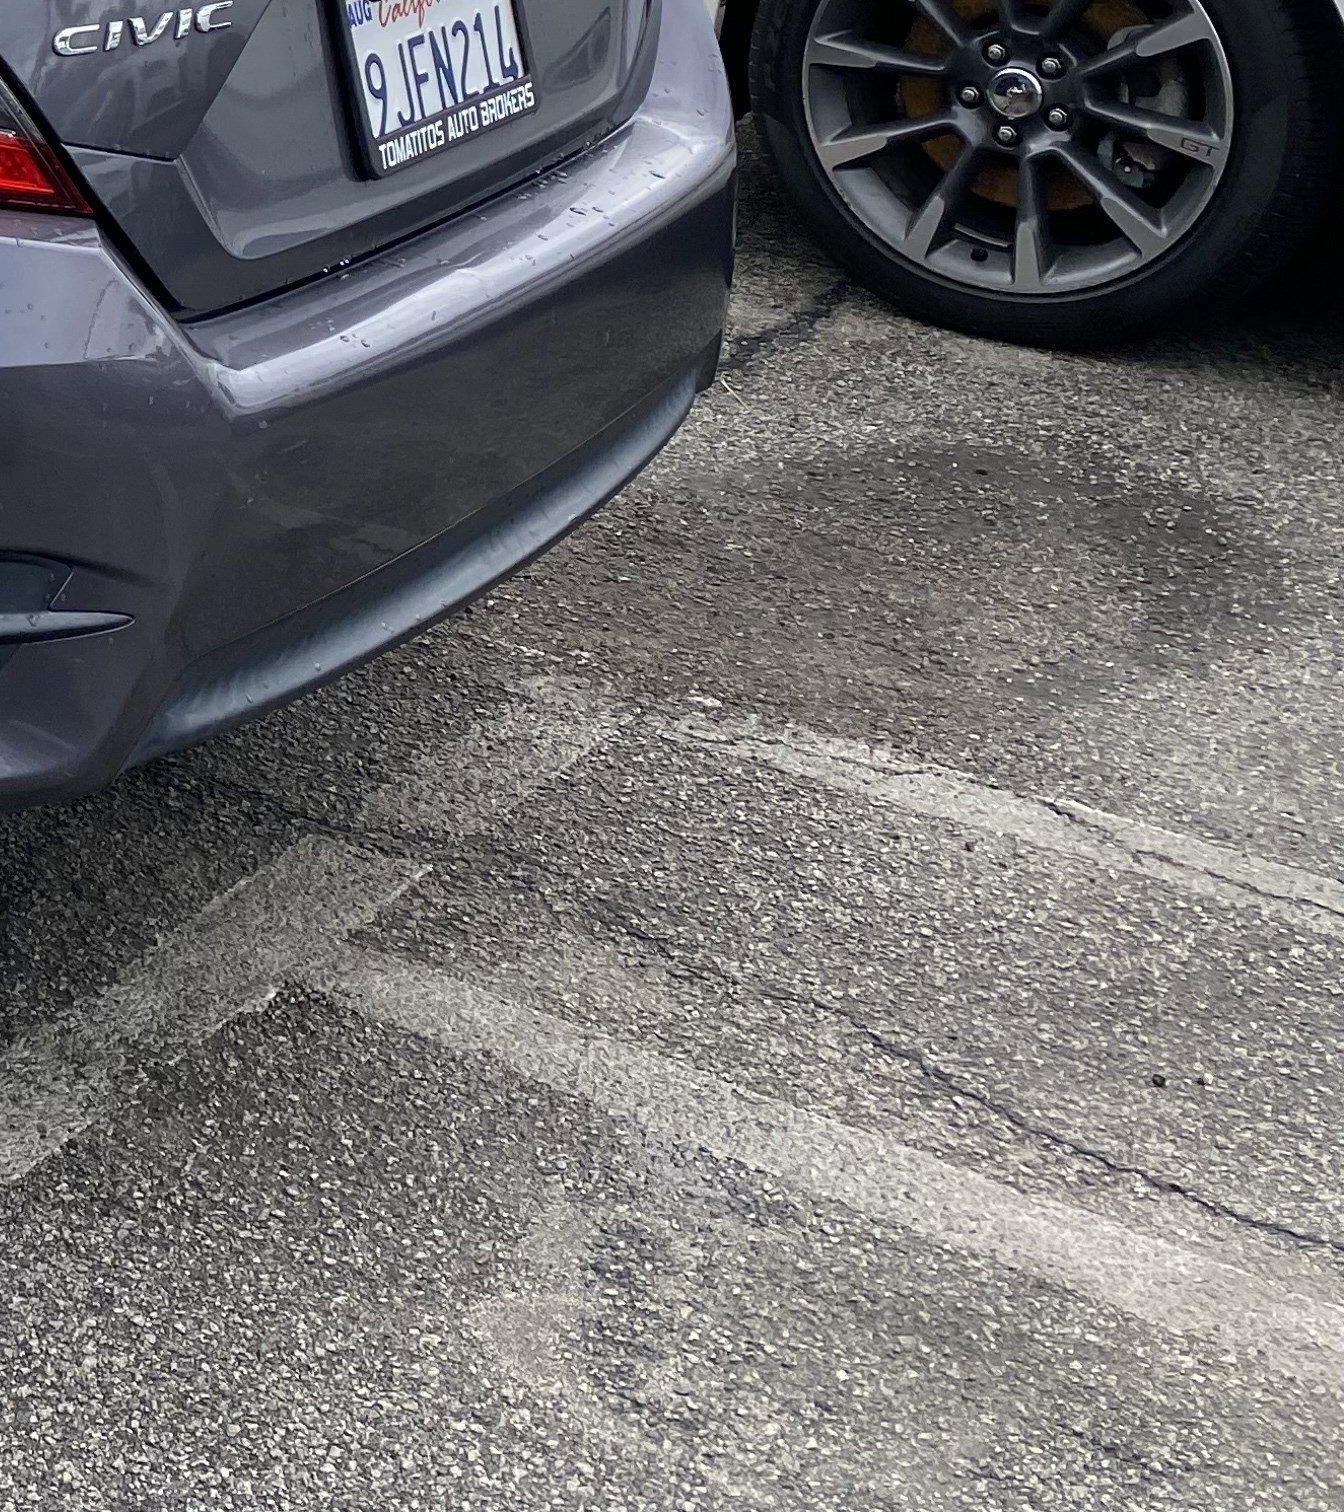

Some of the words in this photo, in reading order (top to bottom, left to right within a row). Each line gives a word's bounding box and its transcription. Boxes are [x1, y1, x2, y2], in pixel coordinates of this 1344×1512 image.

[53, 0, 234, 56] CIVIC
[347, 0, 373, 29] AUG
[364, 4, 519, 139] 9JFN214
[378, 119, 444, 170] TOMATITOS
[447, 105, 479, 141] AUTO
[480, 82, 535, 127] BROKERS
[1180, 137, 1220, 157] GT
